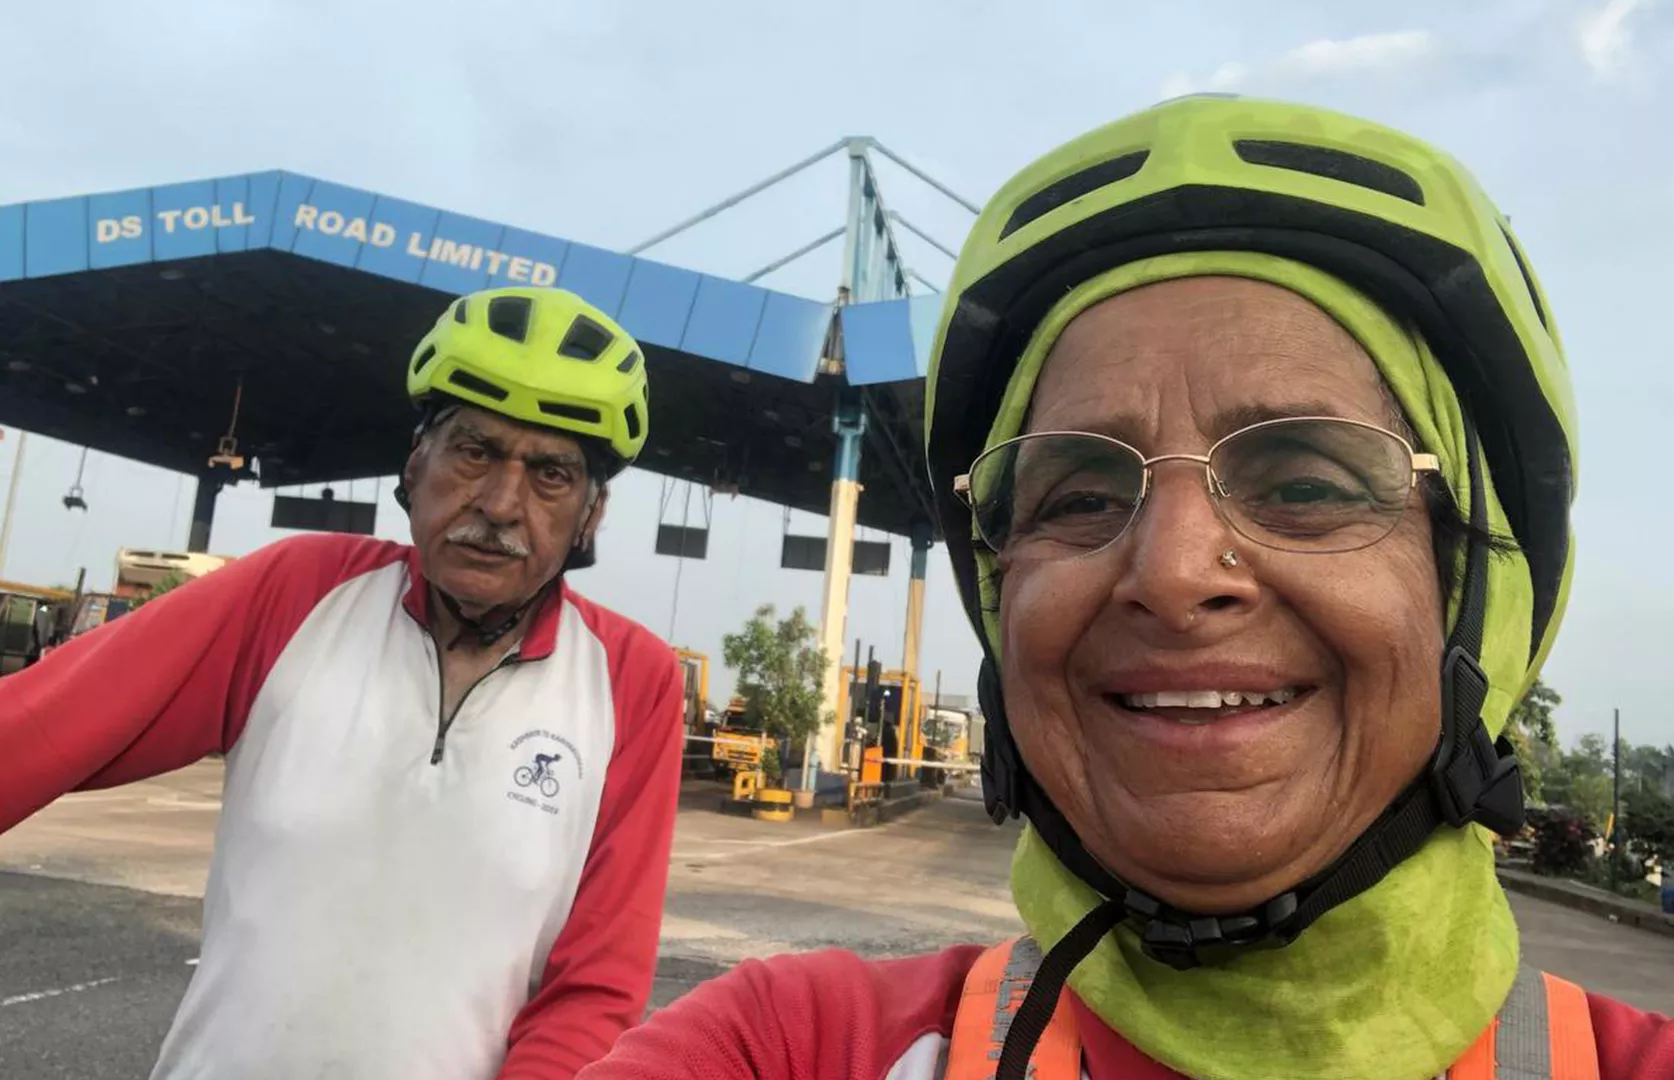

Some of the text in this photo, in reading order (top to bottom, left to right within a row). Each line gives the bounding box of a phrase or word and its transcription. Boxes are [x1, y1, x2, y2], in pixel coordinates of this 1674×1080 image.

[97, 202, 556, 287] DS TOLL ROAD LIMITED
